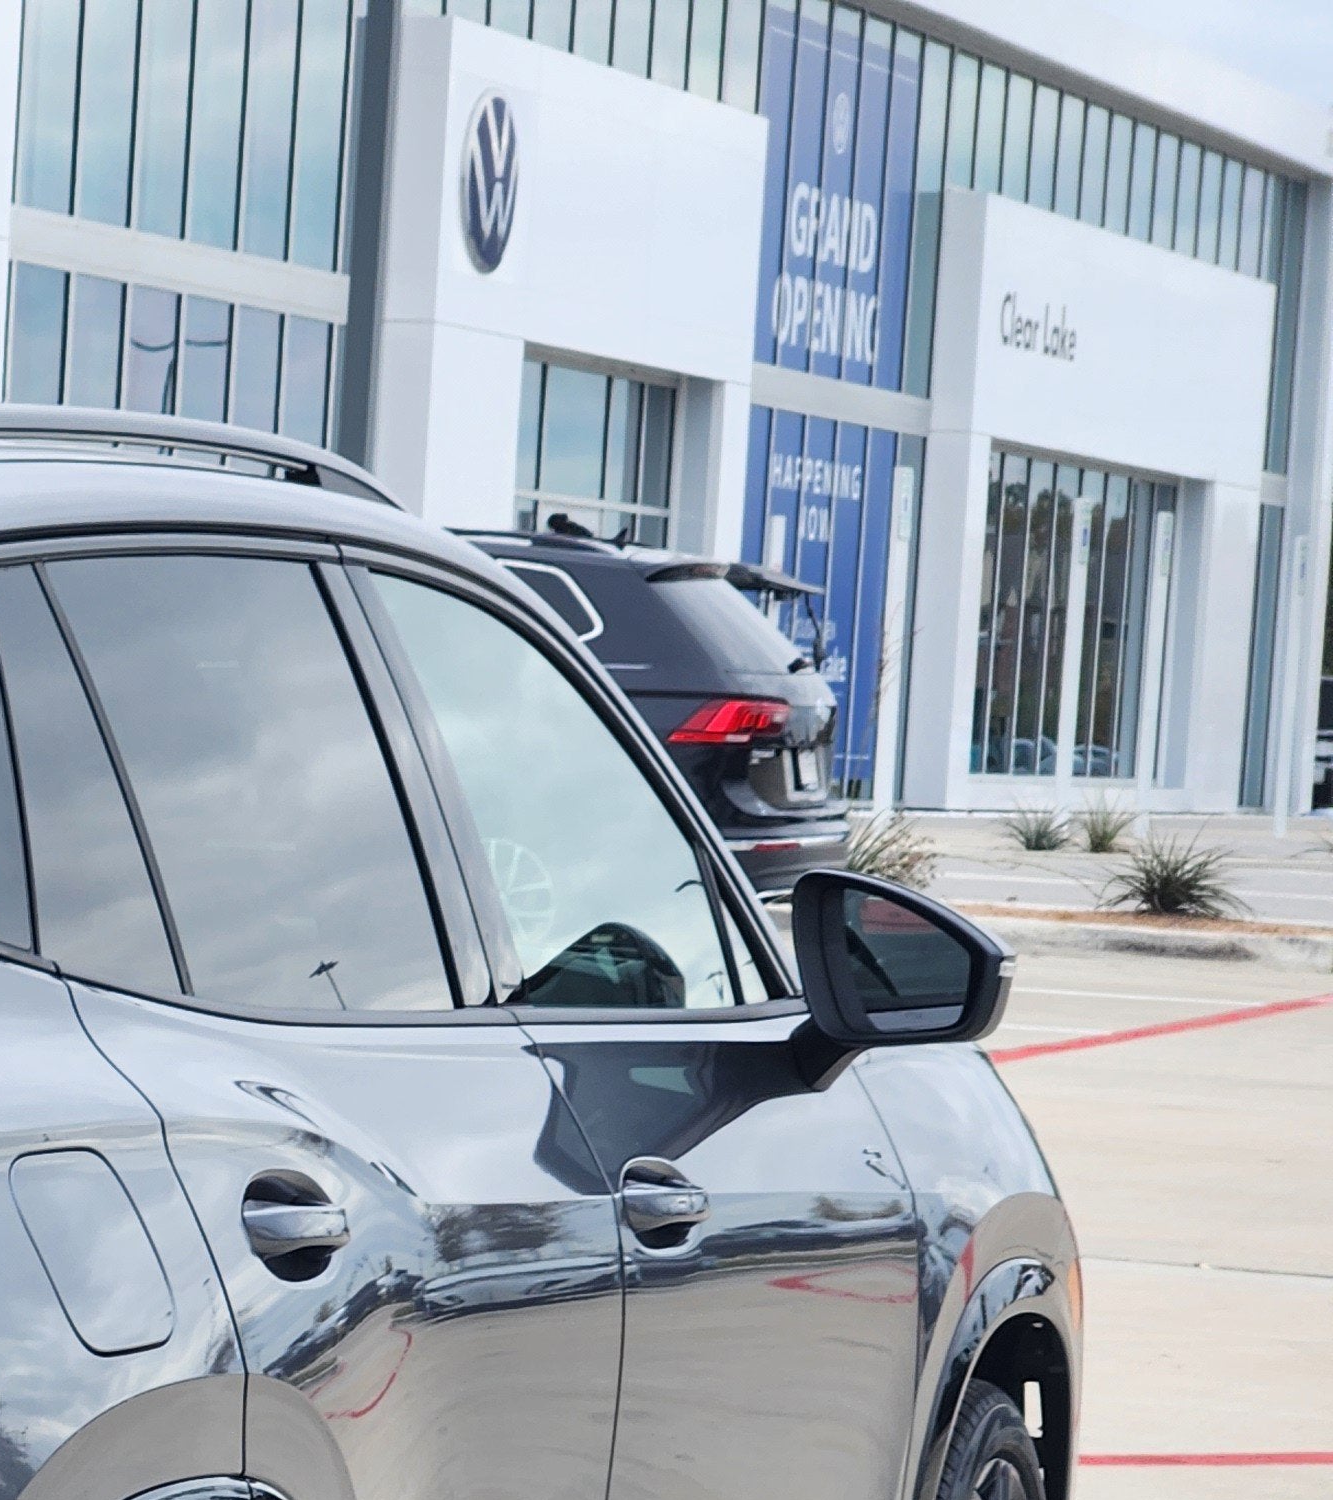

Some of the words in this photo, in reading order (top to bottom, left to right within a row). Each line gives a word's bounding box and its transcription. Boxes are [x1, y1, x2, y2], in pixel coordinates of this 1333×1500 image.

[789, 182, 877, 273] GRAND
[772, 273, 879, 365] OPENING
[1000, 291, 1039, 352] Clear
[1043, 302, 1077, 361] Lake
[771, 453, 862, 501] HAPPENING
